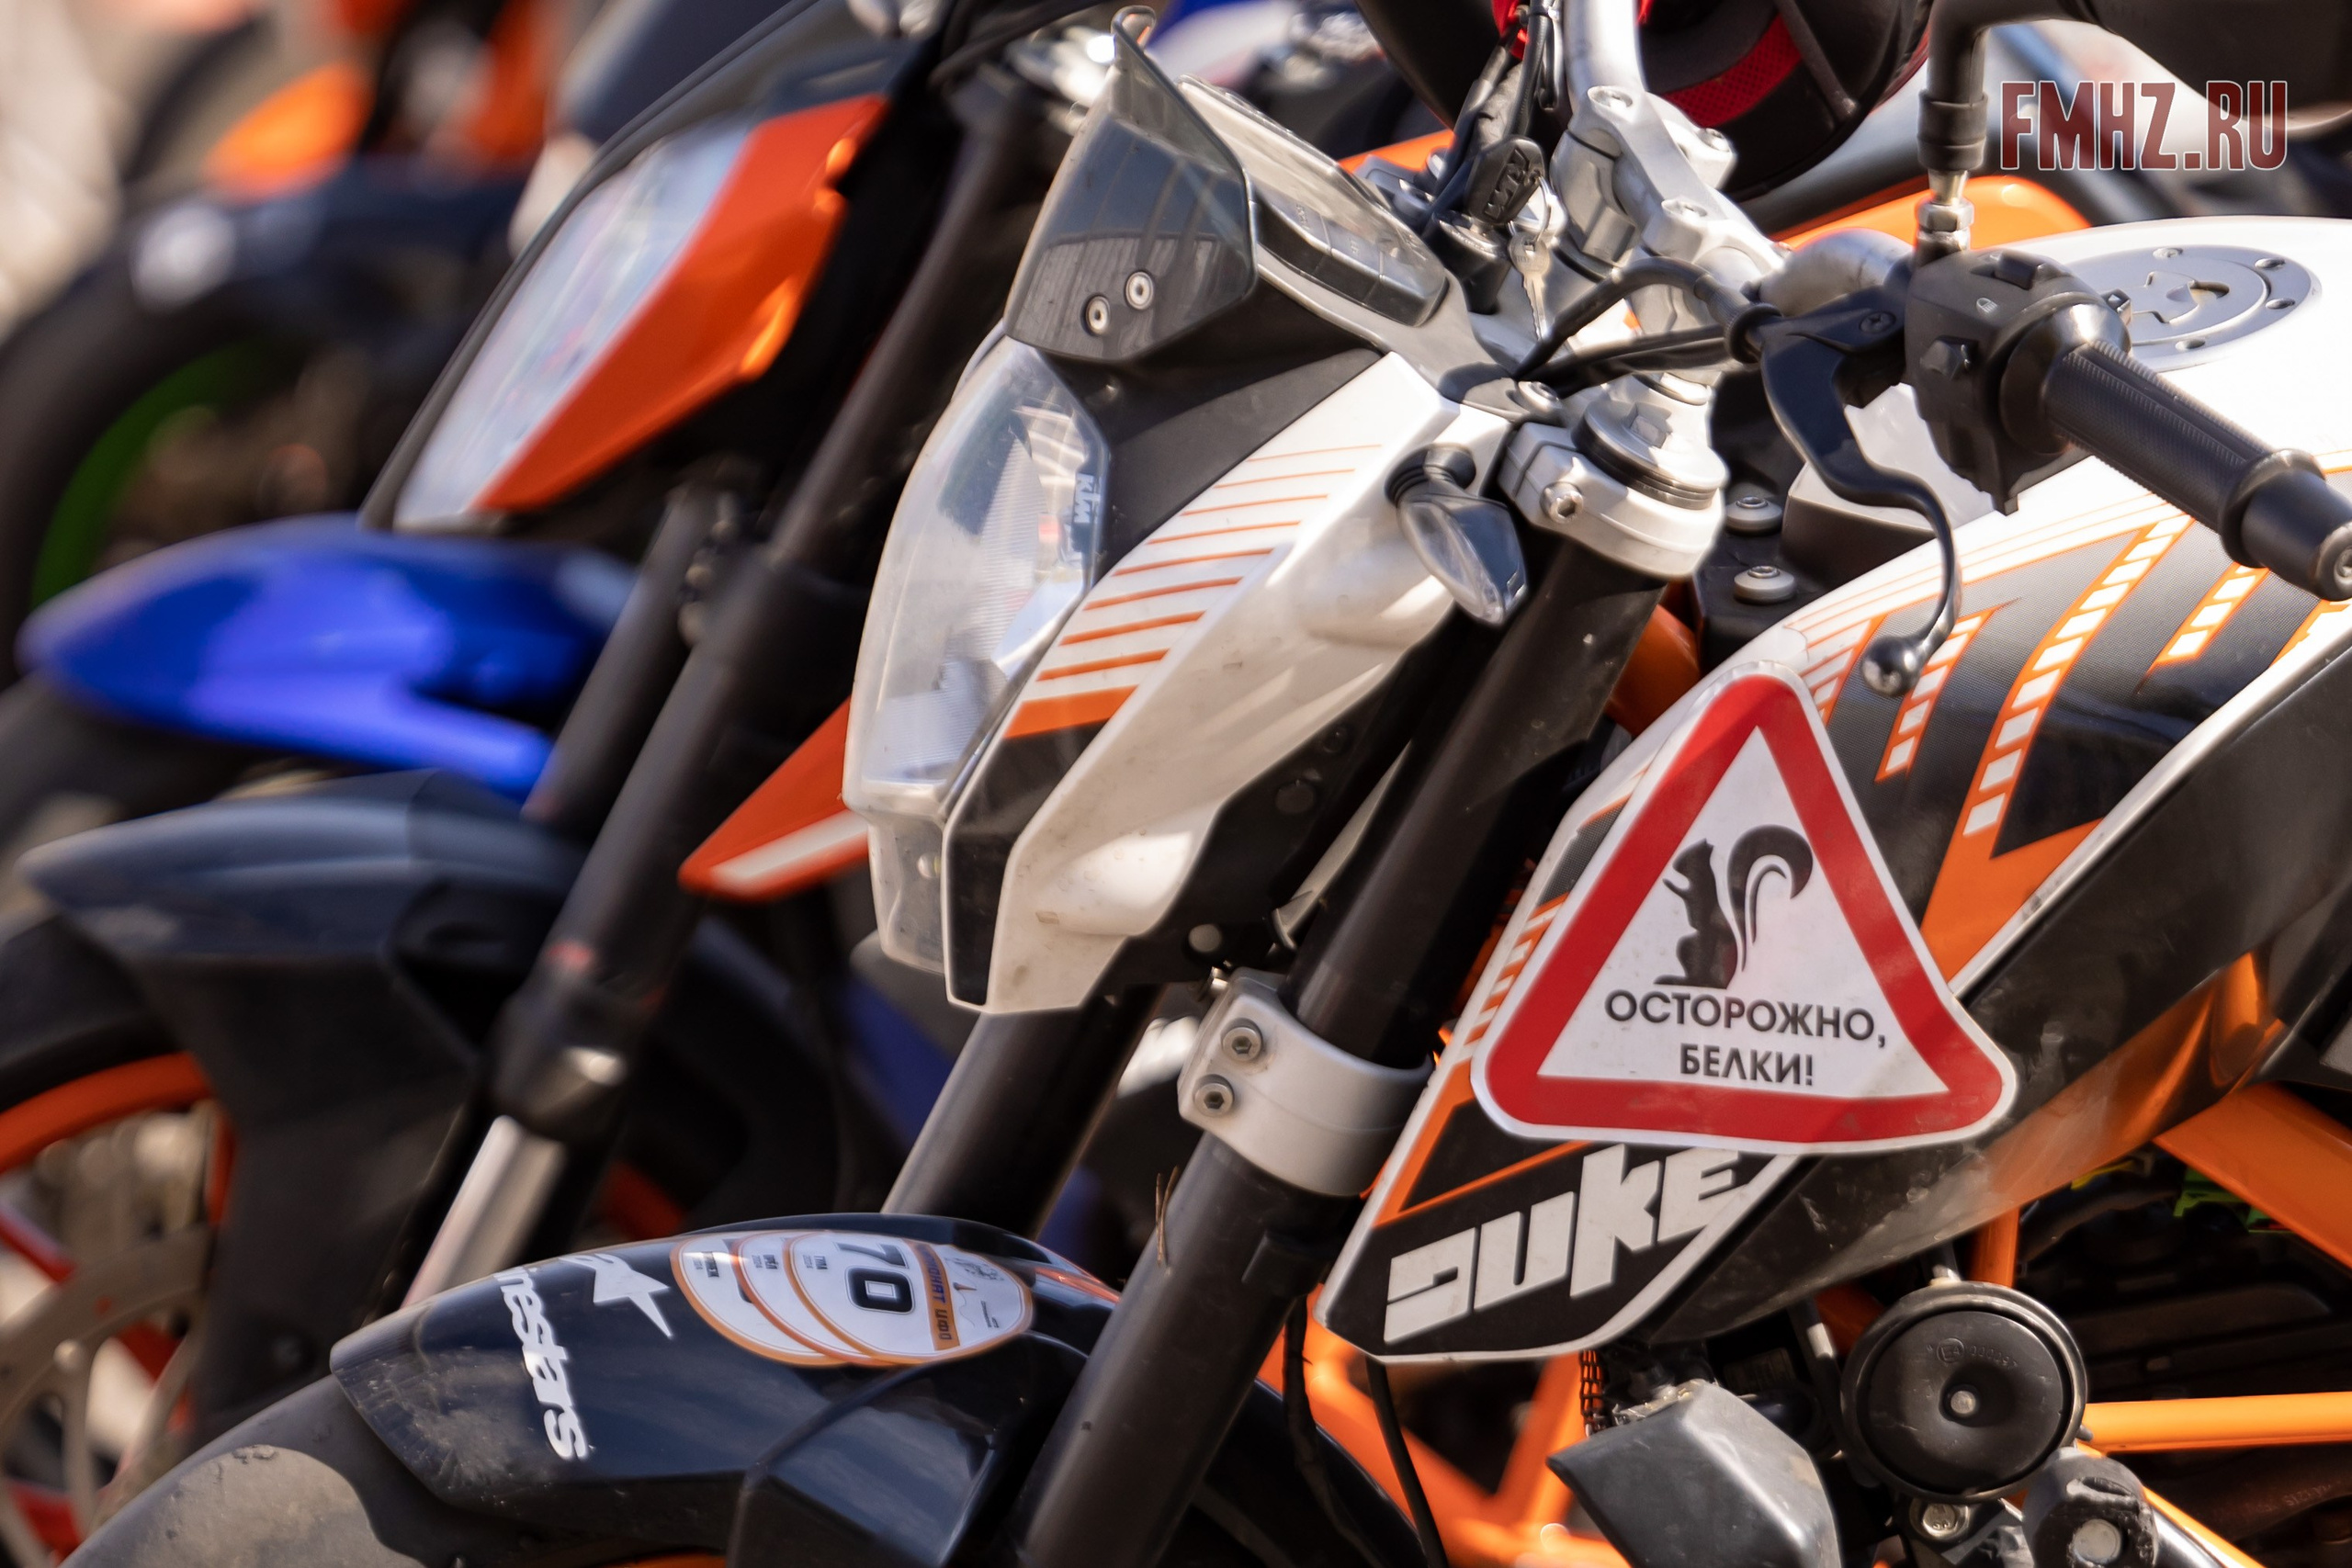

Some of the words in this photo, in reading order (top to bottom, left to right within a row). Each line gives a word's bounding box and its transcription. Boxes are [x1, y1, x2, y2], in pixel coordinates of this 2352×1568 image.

[1073, 472, 1102, 524] KTM
[1604, 989, 1887, 1049] ОСТОРОЖНО,
[1679, 1043, 1814, 1087] БЕЛКИ!
[834, 1242, 914, 1314] 70
